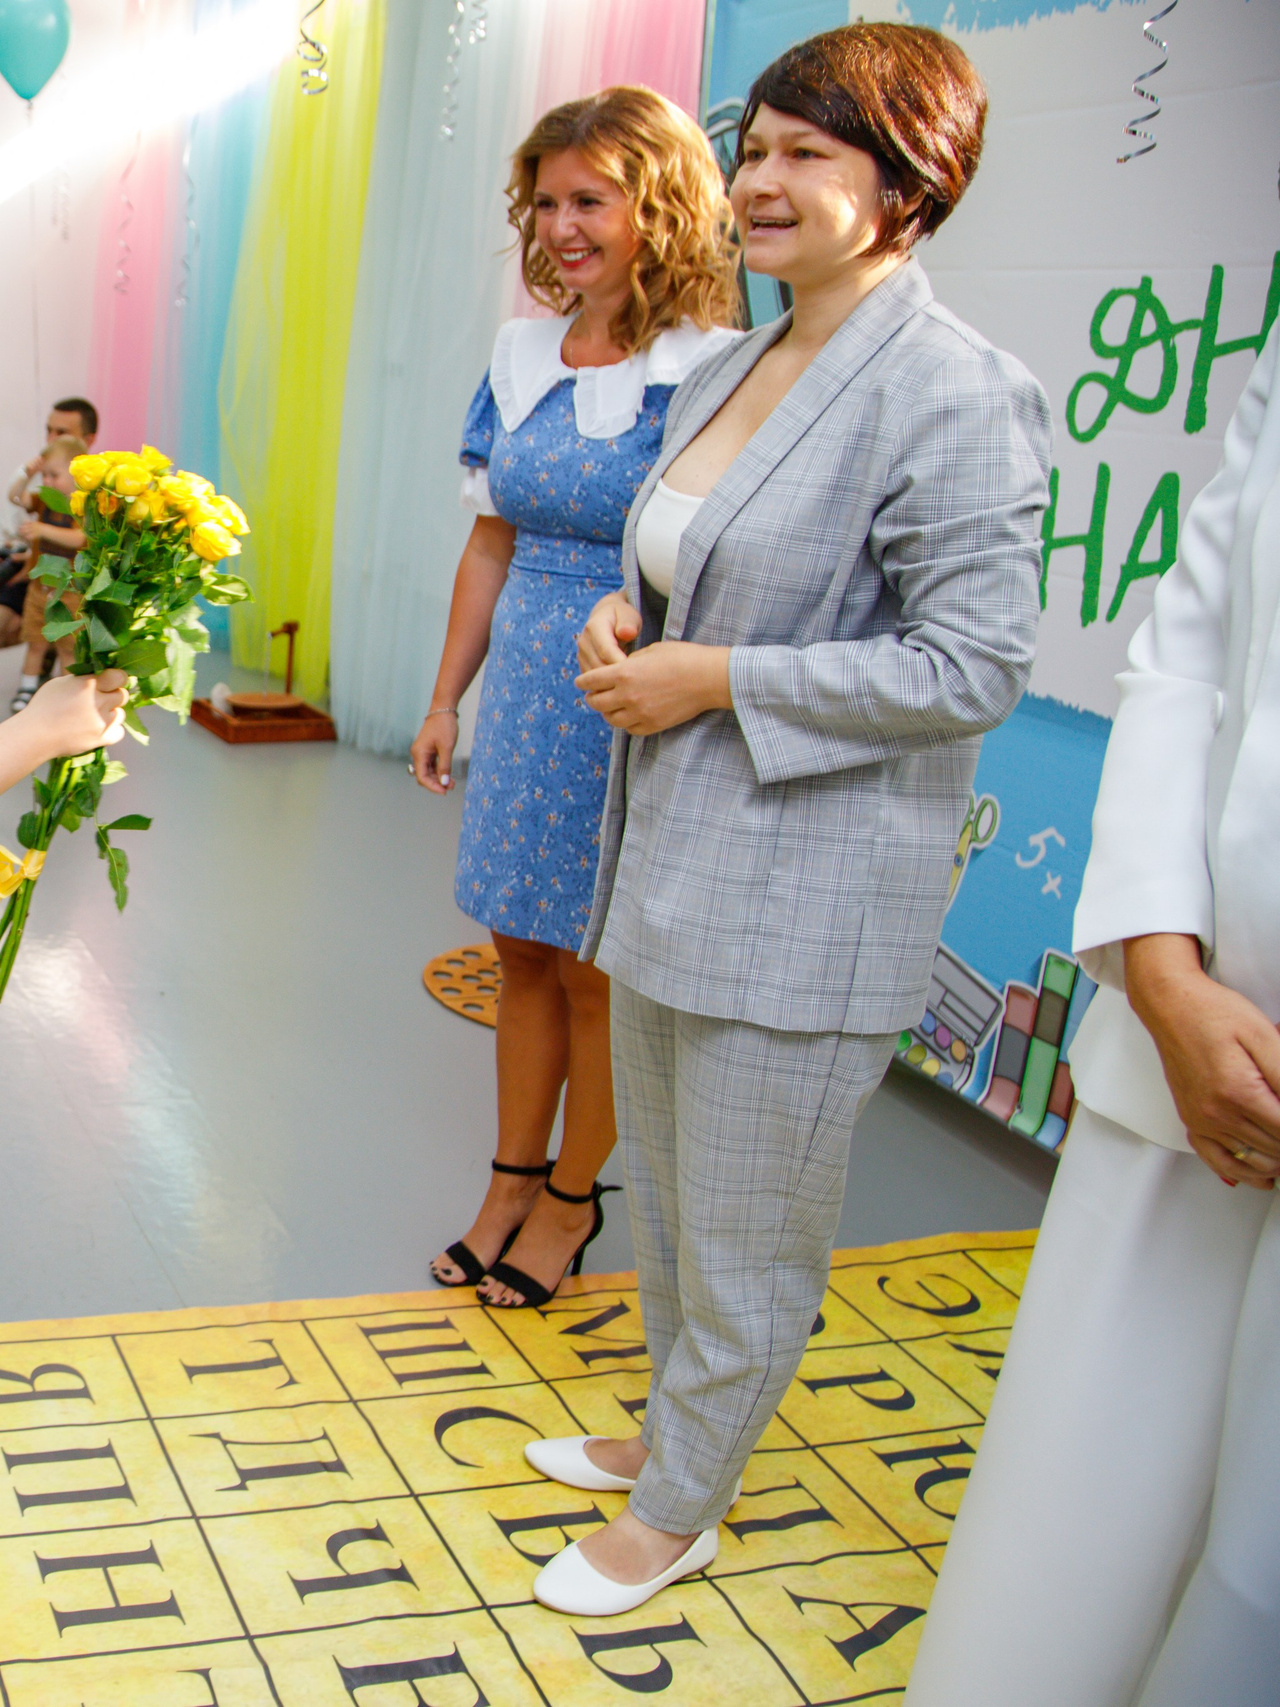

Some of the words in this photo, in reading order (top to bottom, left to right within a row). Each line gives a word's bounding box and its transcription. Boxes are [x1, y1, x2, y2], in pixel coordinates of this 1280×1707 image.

[876, 1273, 982, 1318] Э
[179, 1338, 300, 1391] Т
[357, 1316, 496, 1387] Ш
[535, 1300, 649, 1368] М
[795, 1365, 916, 1411] Р
[189, 1427, 353, 1492] Д
[433, 1406, 546, 1469] С
[1, 1438, 138, 1517] П
[34, 1539, 186, 1638] Н
[286, 1519, 420, 1605] Ч
[571, 1612, 708, 1693] Ь
[783, 1585, 927, 1672] А
